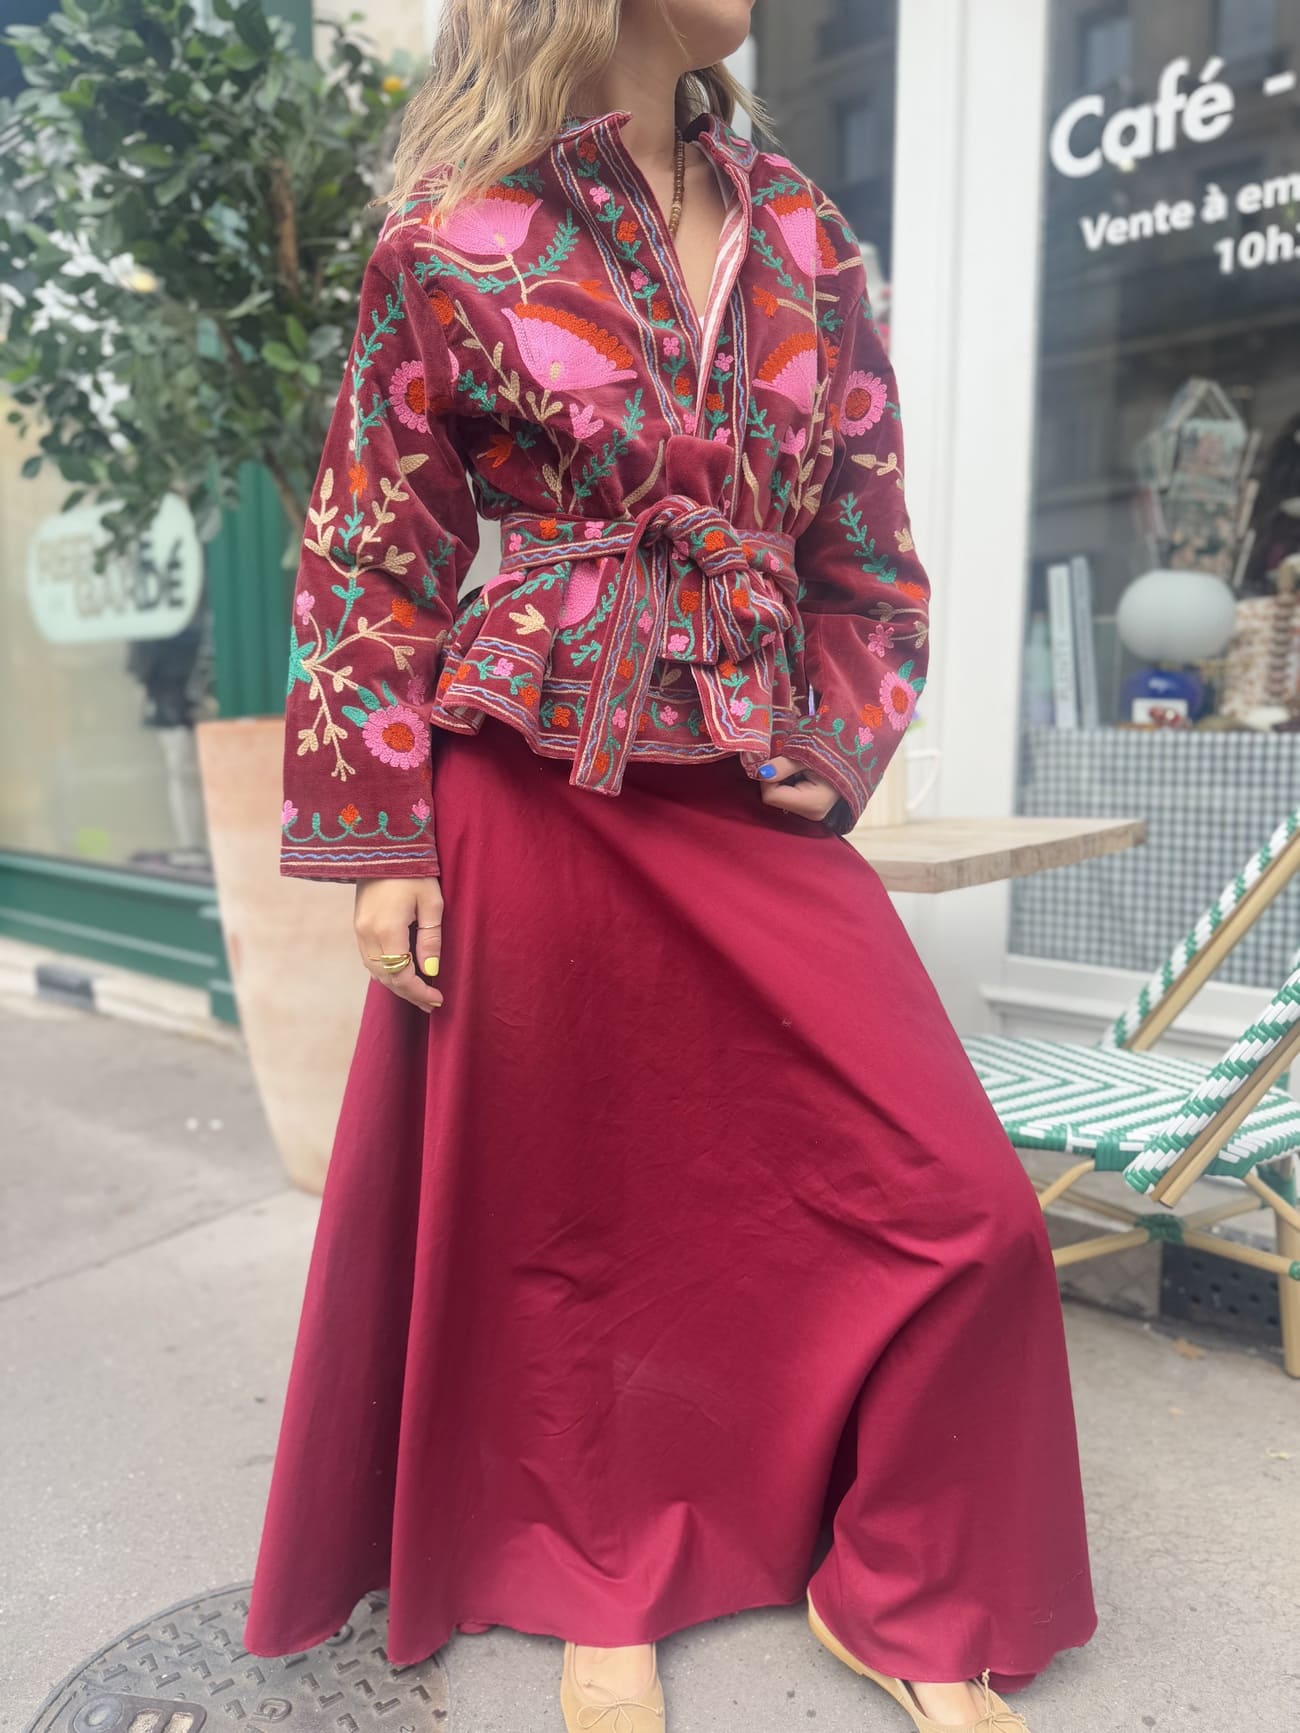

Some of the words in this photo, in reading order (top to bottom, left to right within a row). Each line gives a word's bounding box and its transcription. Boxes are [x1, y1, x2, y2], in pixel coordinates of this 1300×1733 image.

[1050, 57, 1235, 178] Café
[1080, 200, 1196, 250] Vente
[1201, 183, 1228, 223] à
